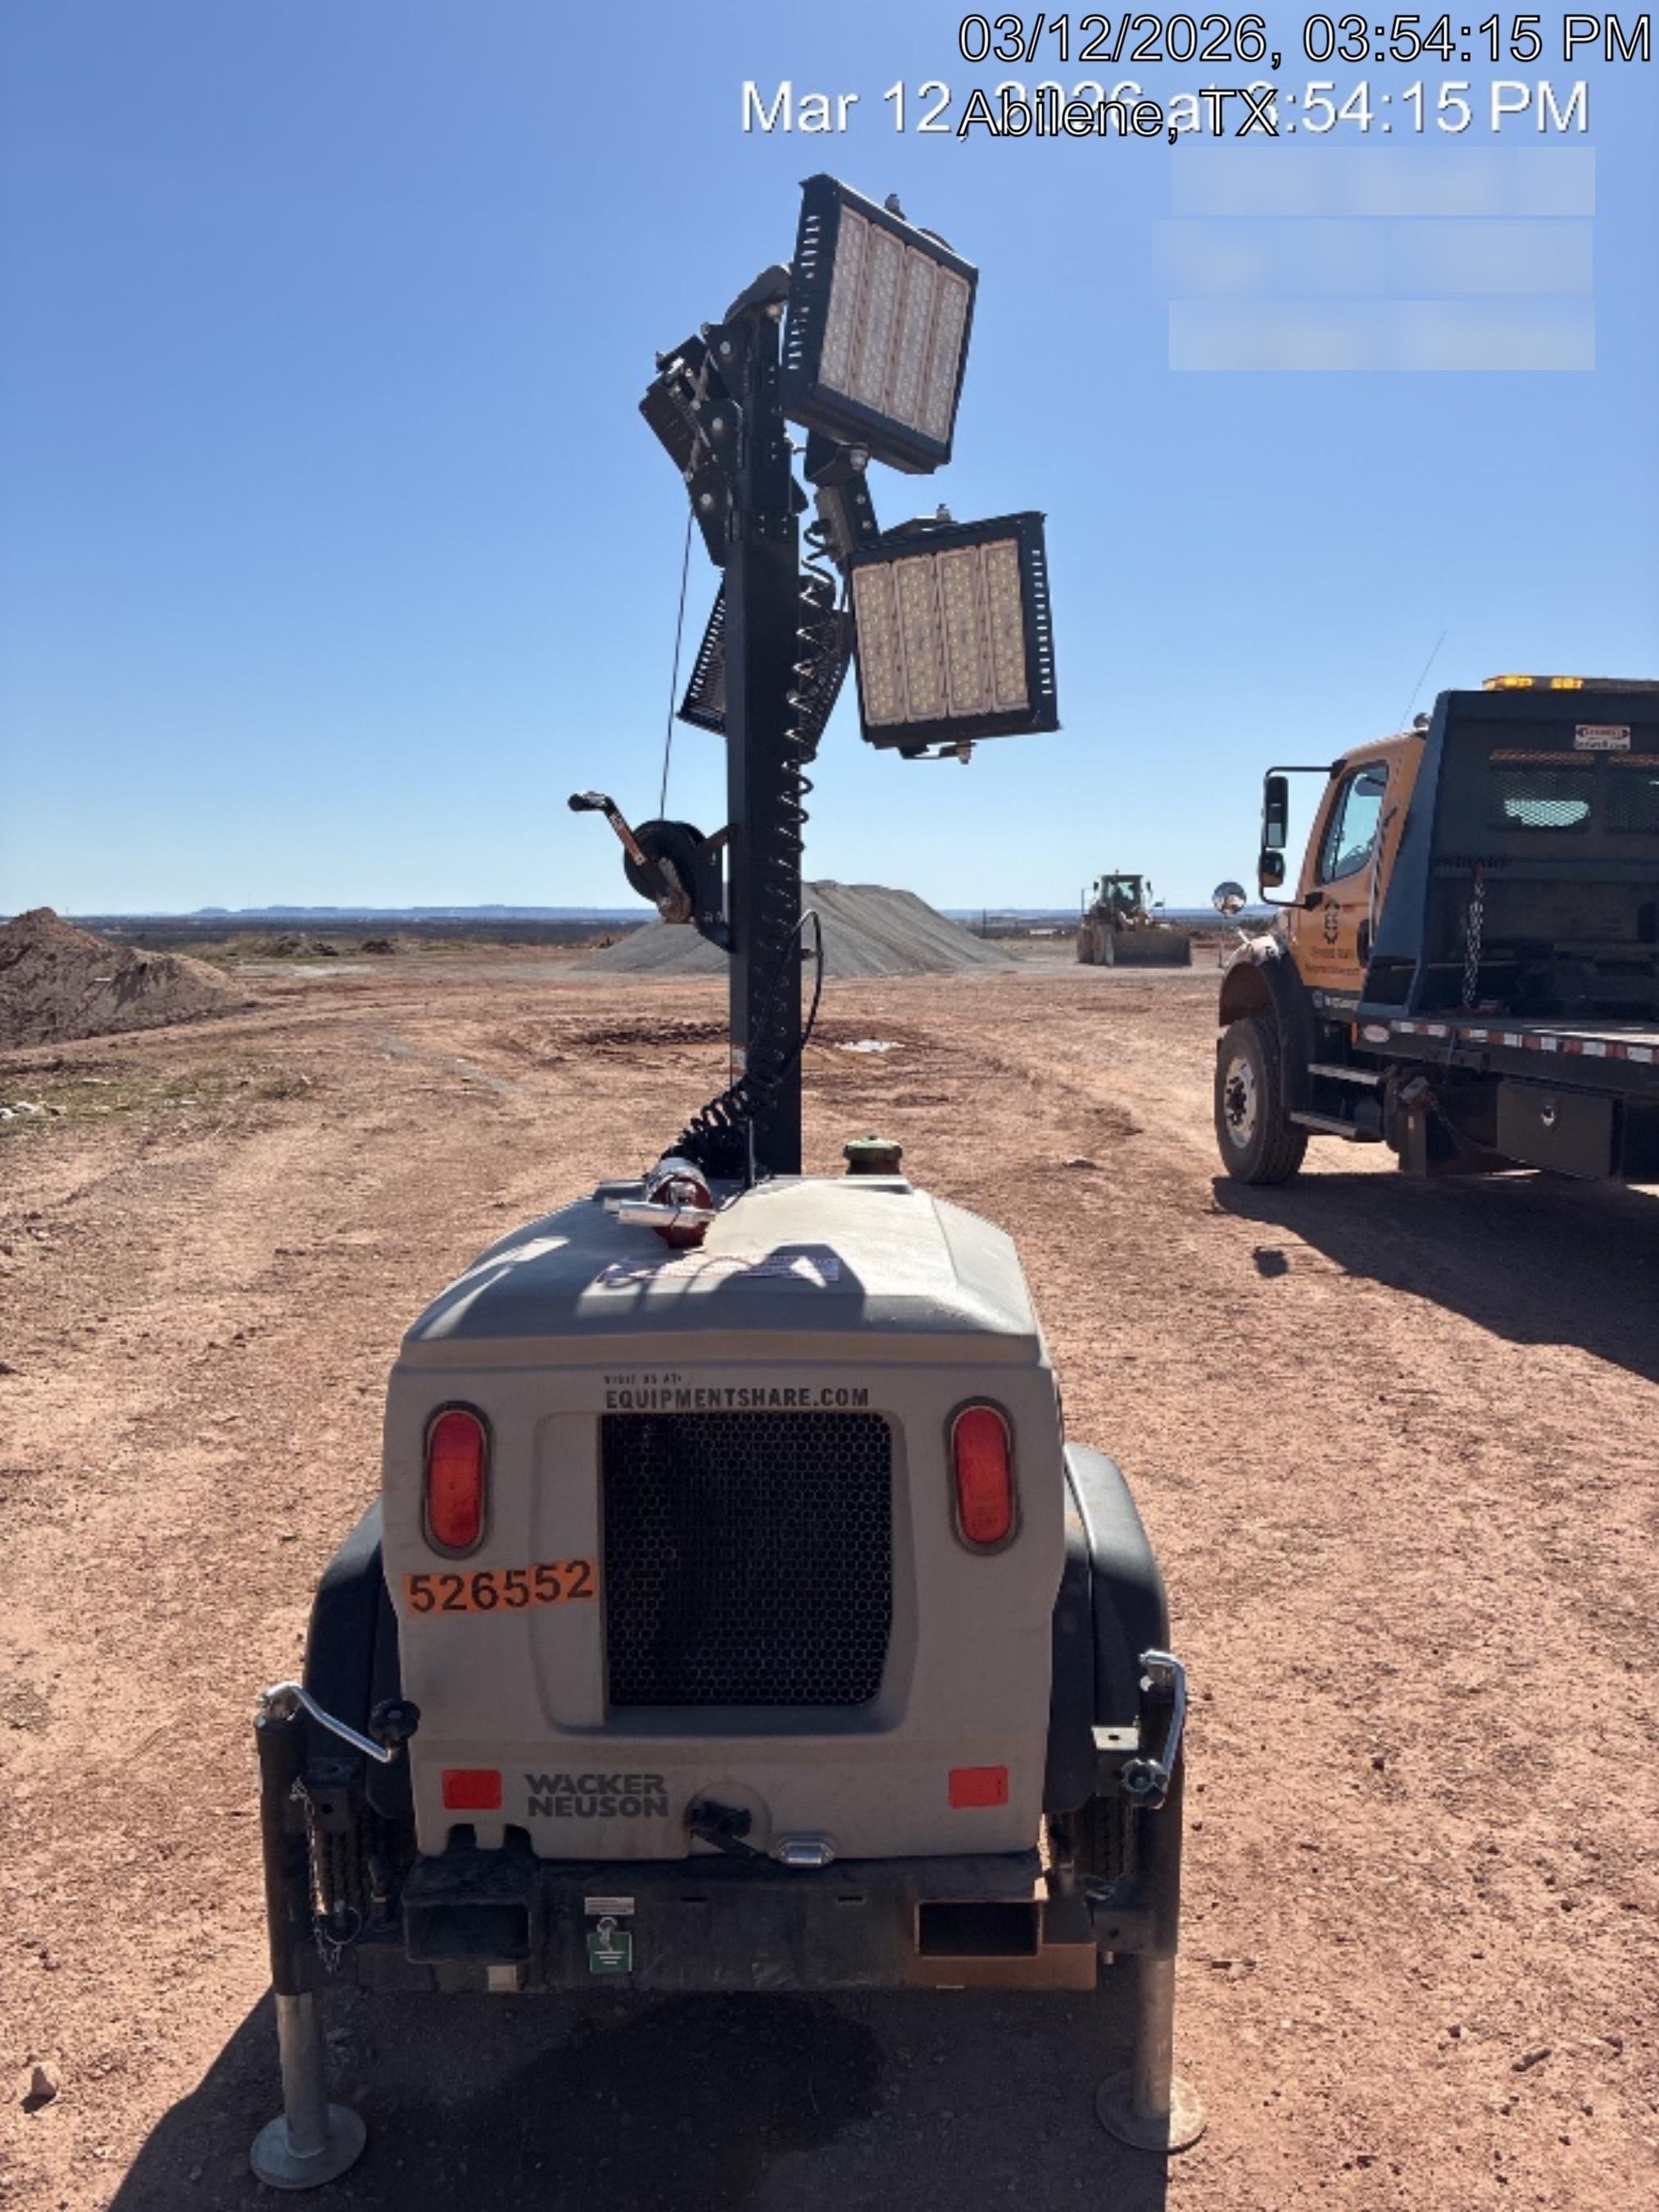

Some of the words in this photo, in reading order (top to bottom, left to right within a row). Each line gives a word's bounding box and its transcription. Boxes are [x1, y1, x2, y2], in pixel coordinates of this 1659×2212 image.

[605, 1388, 869, 1409] EQUIPMENTSHARE.COM
[410, 1559, 594, 1613] 526552
[524, 1773, 669, 1795] WACKER
[528, 1795, 669, 1818] NEUSON
